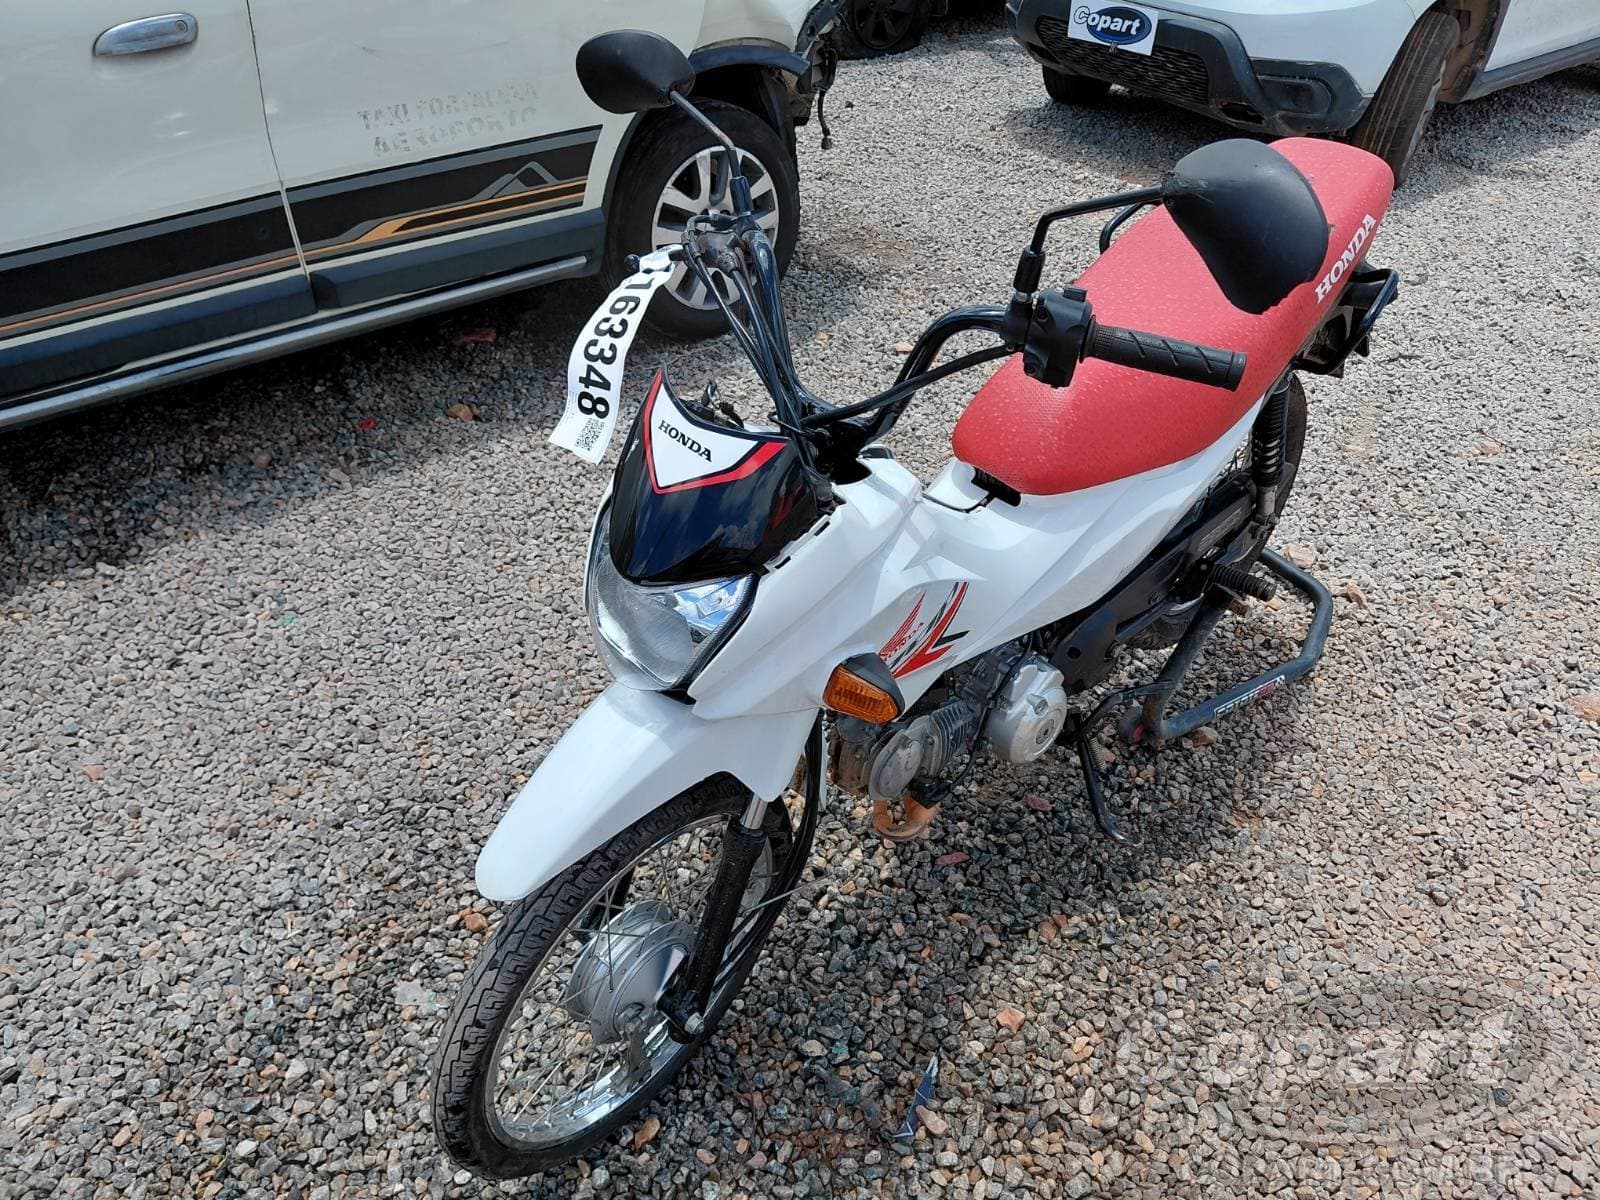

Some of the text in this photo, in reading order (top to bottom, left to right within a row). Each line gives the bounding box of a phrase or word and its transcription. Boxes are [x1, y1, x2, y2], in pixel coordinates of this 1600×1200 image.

[1074, 5, 1141, 36] Copart
[1315, 213, 1377, 304] HONDA
[658, 420, 713, 463] HONDA
